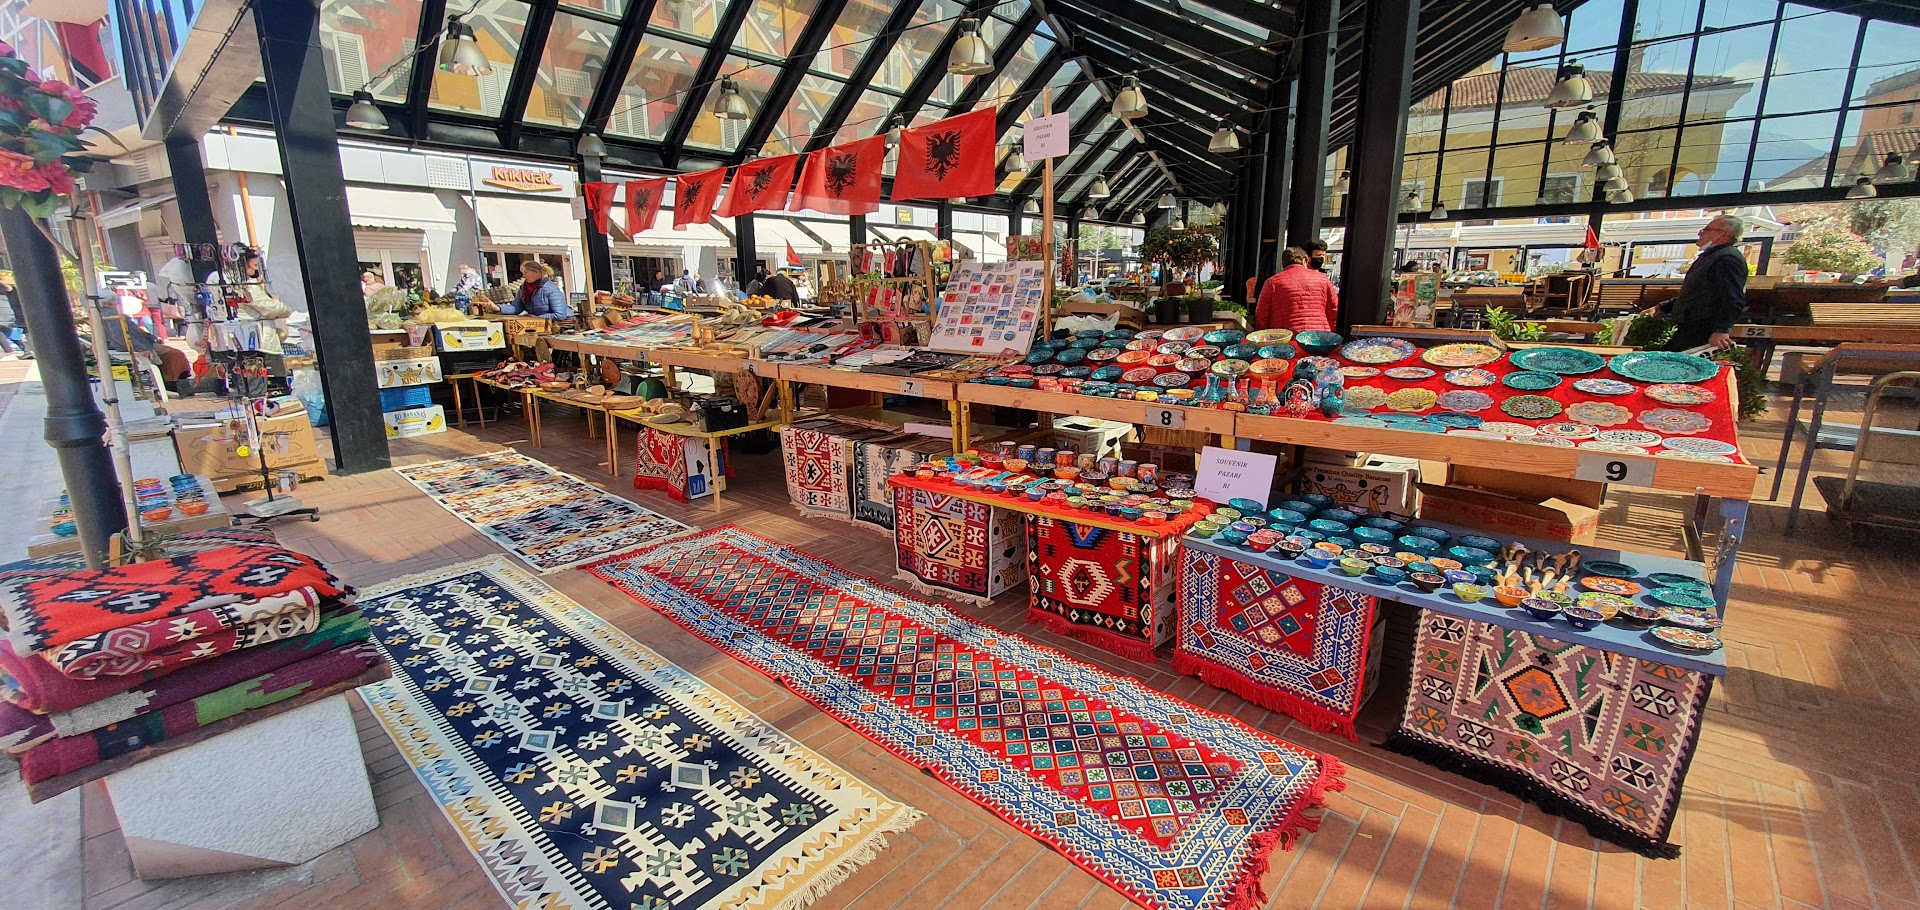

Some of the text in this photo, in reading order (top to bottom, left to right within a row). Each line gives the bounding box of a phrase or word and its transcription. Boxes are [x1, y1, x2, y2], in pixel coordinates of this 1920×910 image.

[1746, 327, 1766, 337] 52
[640, 351, 645, 359] 5
[748, 364, 754, 372] 6
[401, 376, 422, 385] KING
[906, 381, 914, 390] 7
[1160, 410, 1172, 425] 8
[1215, 458, 1248, 468] SOUVENIR
[1217, 470, 1242, 479] PAZARI
[1313, 467, 1341, 476] Premium
[1341, 470, 1365, 479] Quality
[1365, 473, 1391, 482] Bananas
[1605, 461, 1628, 481] 9
[1001, 523, 1018, 539] KING
[1003, 572, 1019, 588] KING
[1165, 623, 1176, 639] KIN
